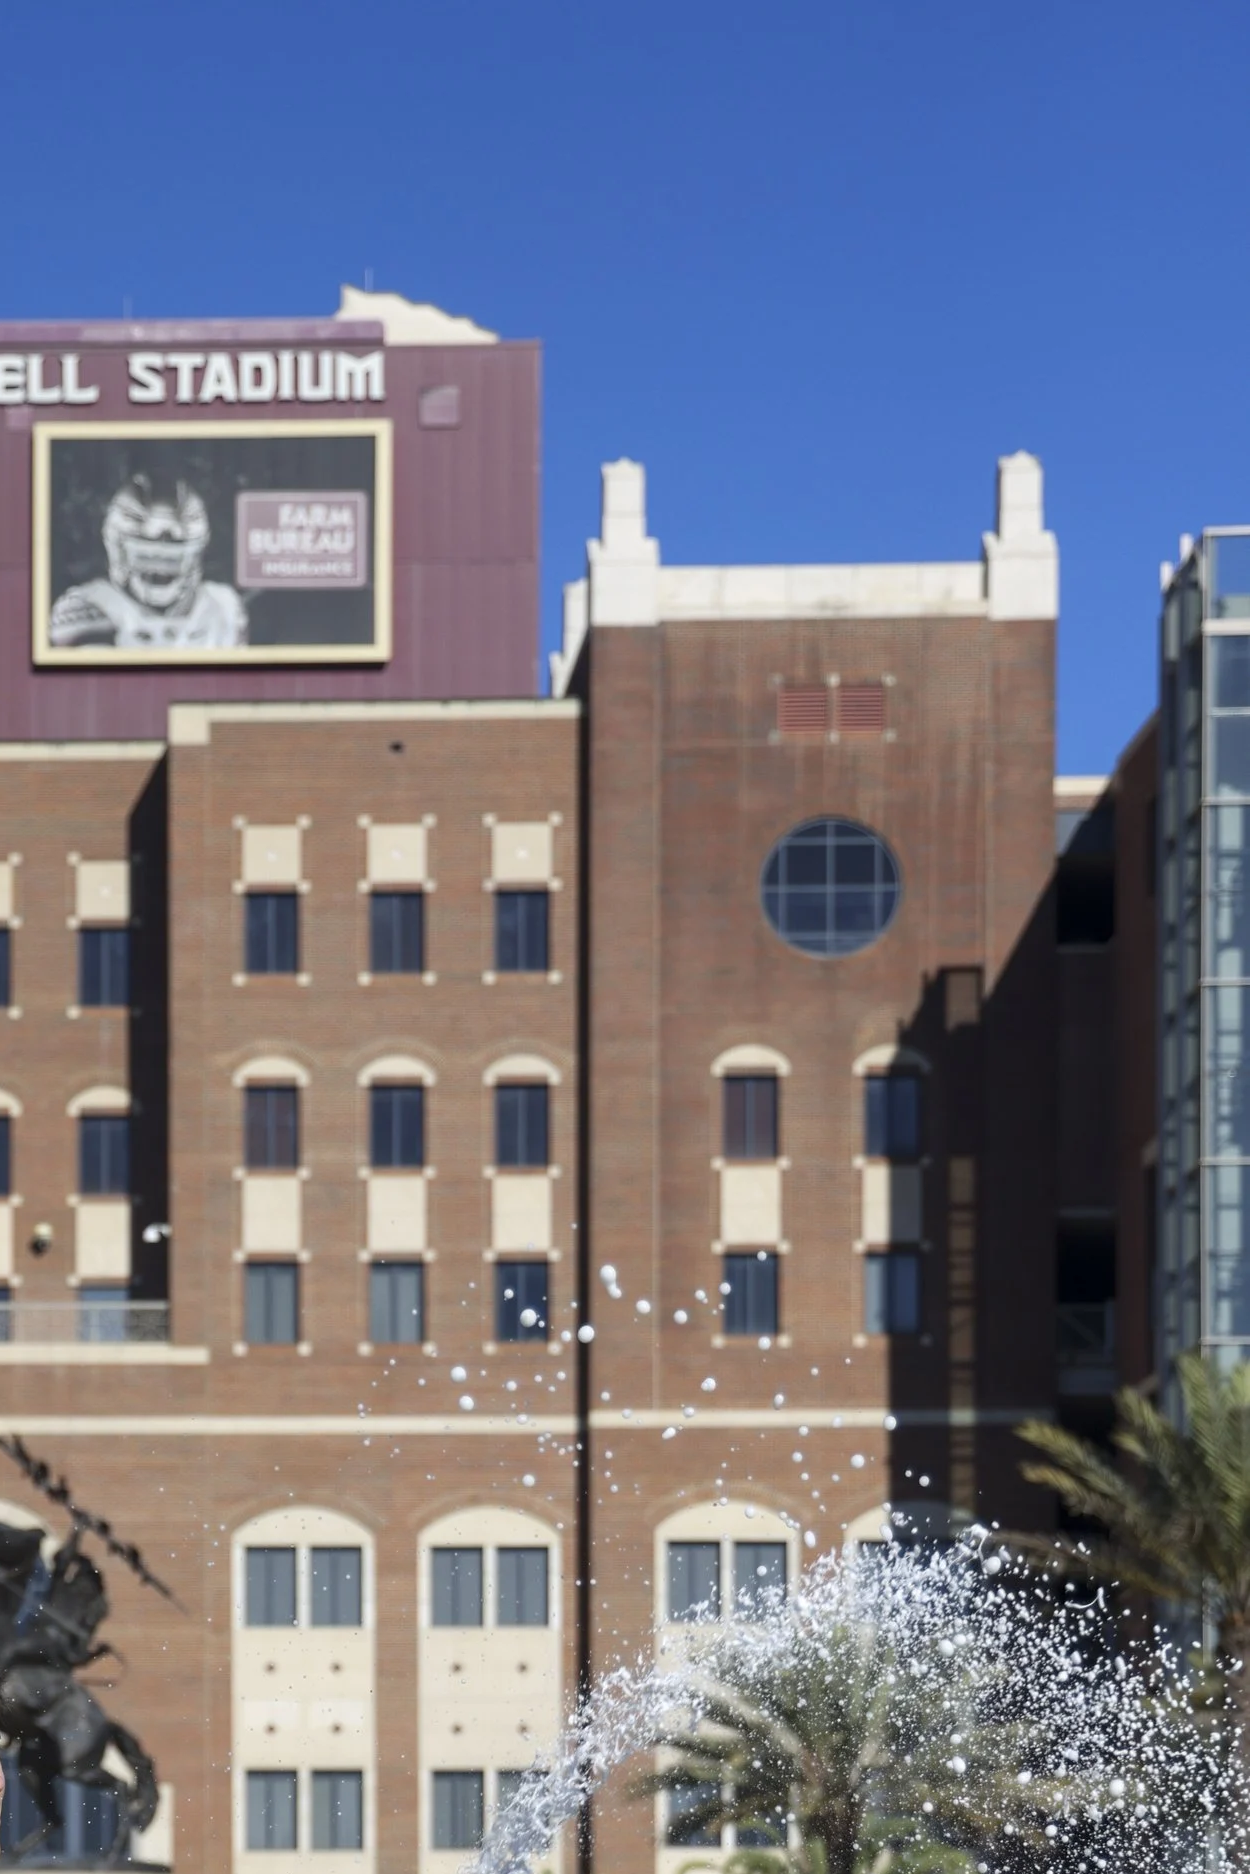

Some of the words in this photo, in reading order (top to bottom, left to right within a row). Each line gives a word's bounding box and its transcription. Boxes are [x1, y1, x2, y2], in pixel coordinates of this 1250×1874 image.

[127, 350, 386, 403] STADIUM
[278, 503, 354, 527] FARM
[248, 528, 355, 554] BUREAU
